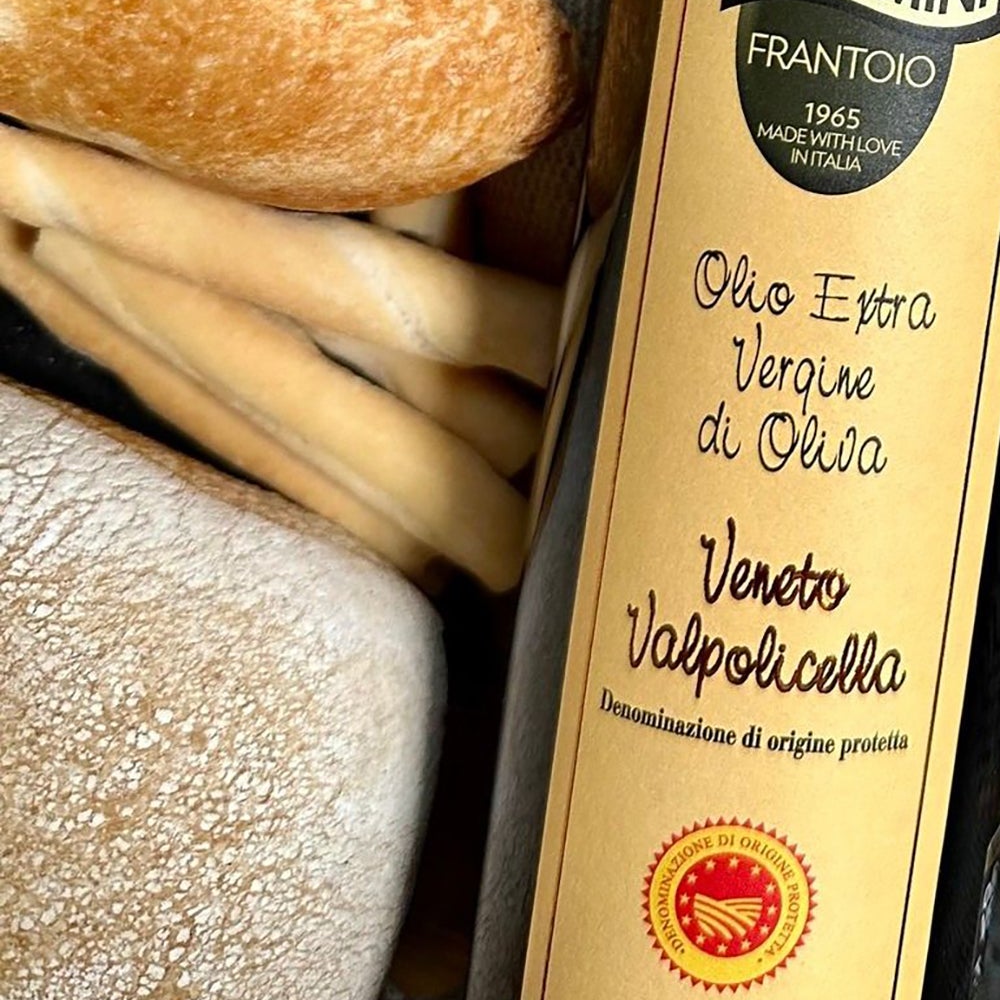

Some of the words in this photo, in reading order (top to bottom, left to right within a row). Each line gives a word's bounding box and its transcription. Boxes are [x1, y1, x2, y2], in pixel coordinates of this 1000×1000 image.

[747, 32, 937, 89] FRANTOIO
[757, 122, 807, 146] MADE
[810, 130, 856, 153] WITH
[857, 136, 903, 158] LOVE
[804, 102, 861, 130] 1965
[790, 148, 810, 165] IN
[811, 150, 862, 173] ITALIA
[694, 250, 795, 316] Olio
[809, 272, 937, 335] Extra
[733, 322, 875, 416] Vergine
[698, 400, 741, 460] di
[758, 411, 887, 475] Oliva
[700, 516, 851, 612] Veneto
[627, 589, 906, 698] Valpolicella
[599, 687, 737, 746] Denominazione
[741, 725, 761, 750] di
[767, 732, 835, 760] origine
[839, 730, 908, 761] protetta
[718, 834, 735, 847] DI
[740, 836, 796, 882] ORIGINE
[657, 835, 714, 955] DENOMINAZIONE
[764, 883, 801, 957] PROTETTA
